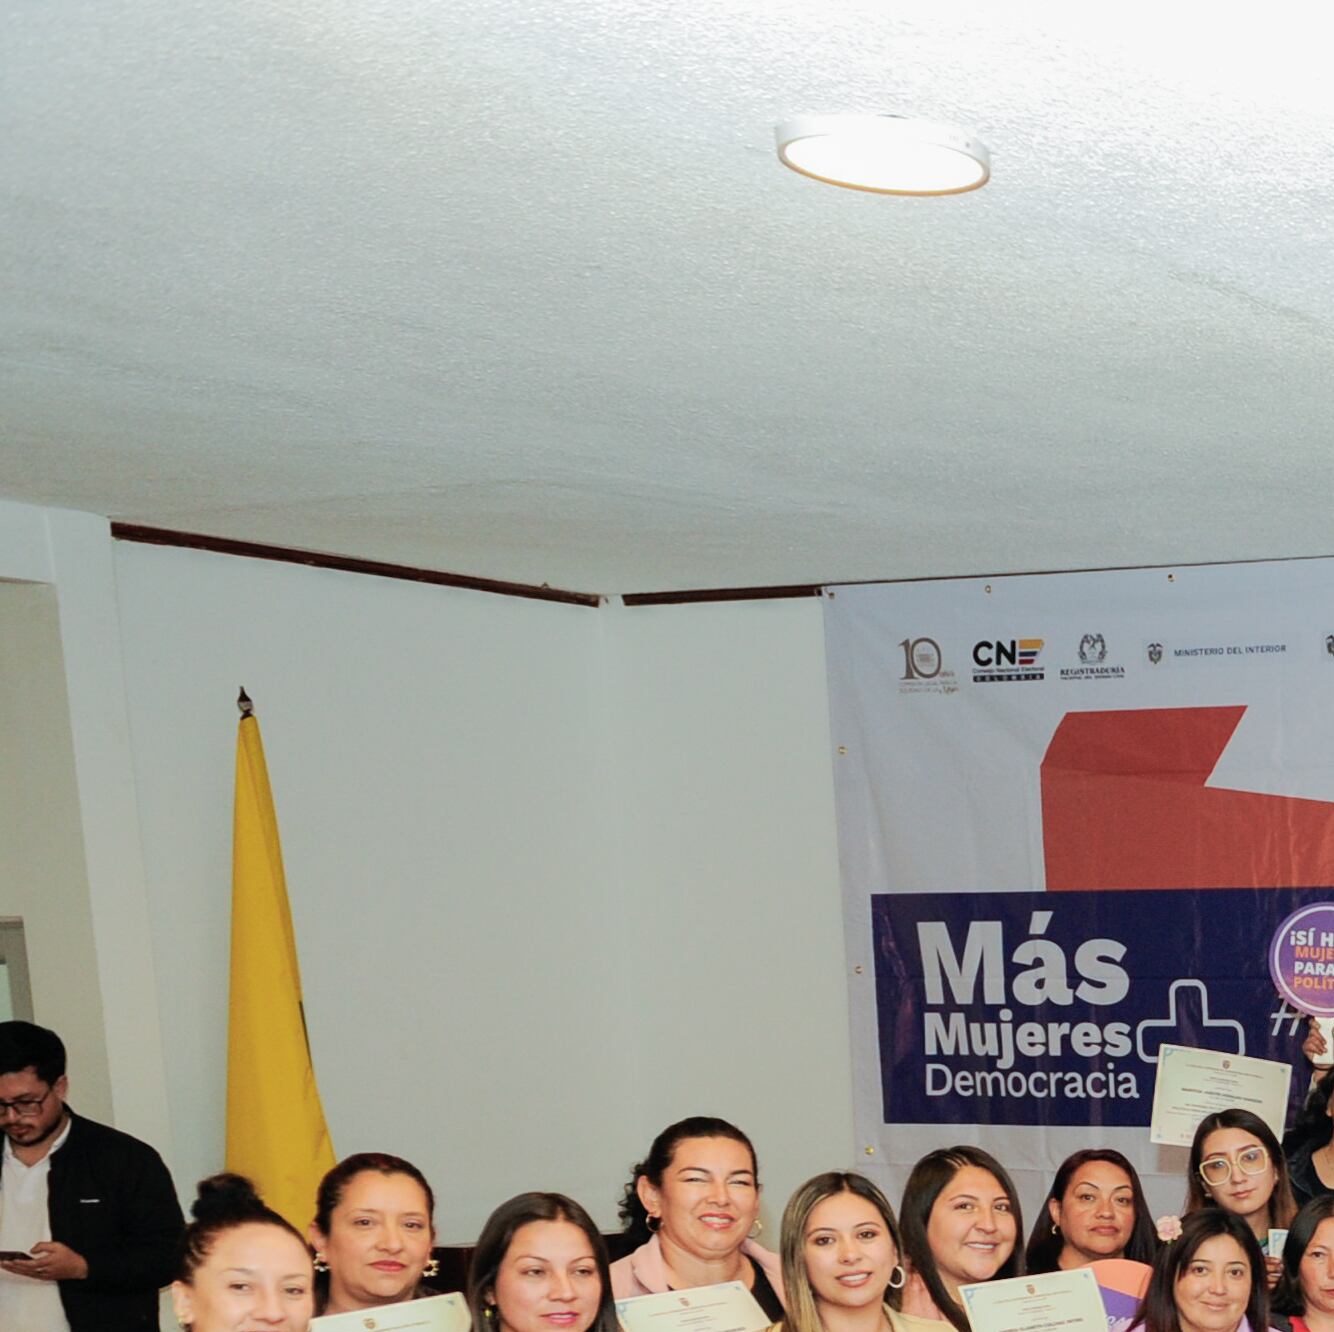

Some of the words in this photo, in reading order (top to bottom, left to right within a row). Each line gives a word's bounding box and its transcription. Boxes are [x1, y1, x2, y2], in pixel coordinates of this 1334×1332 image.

[1174, 647, 1224, 657] MINISTERIO
[1227, 646, 1242, 655] DEL
[1245, 645, 1286, 653] INTERIOR
[916, 910, 1130, 1005] Más
[924, 1009, 1132, 1068] Mujeres
[925, 1062, 1139, 1098] Democracia
